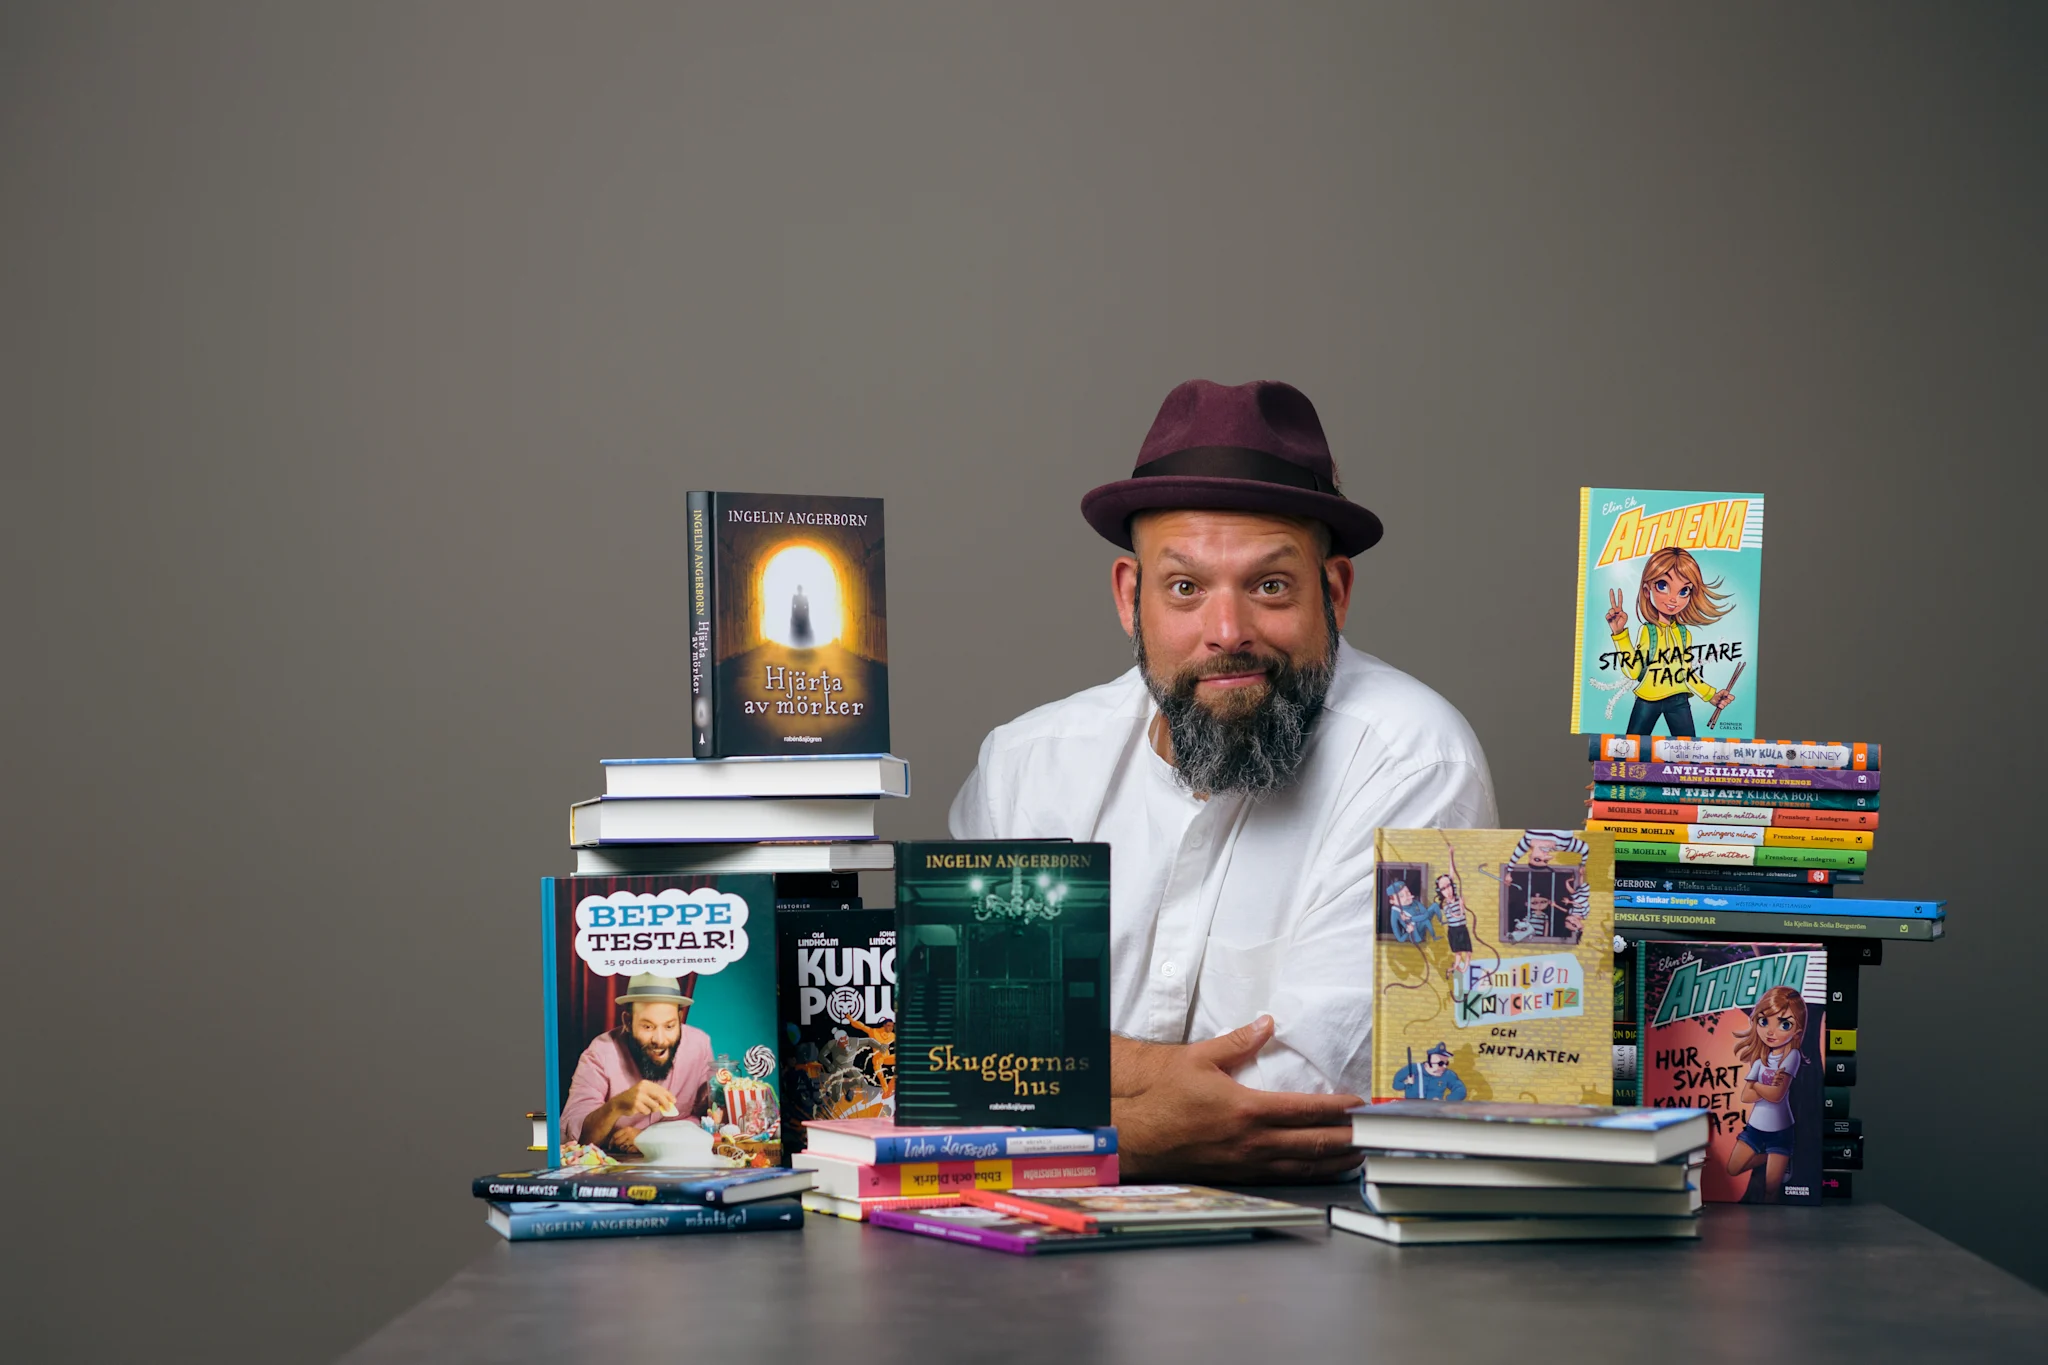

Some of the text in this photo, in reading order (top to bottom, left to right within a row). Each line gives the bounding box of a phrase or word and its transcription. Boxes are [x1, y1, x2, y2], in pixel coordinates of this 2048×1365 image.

[1602, 496, 1637, 515] Elin Ek
[728, 510, 868, 526] INGELIN ANGERBORN
[1597, 500, 1749, 567] ATHENA
[694, 510, 705, 616] INGELIN ANGERBORN
[695, 621, 710, 658] Hjärta
[1599, 641, 1742, 670] STRÅLKASTARE
[692, 637, 703, 694] av mörker
[765, 666, 843, 698] Hjärta
[1649, 666, 1704, 686] TACK!
[744, 691, 864, 715] av mörker
[1663, 741, 1690, 753] Dagbok
[1734, 748, 1841, 761] PÅ NY KULA KINNEY
[1676, 751, 1689, 759] alla
[1712, 751, 1729, 760] fans
[1662, 765, 1775, 778] ANTI-KILLPAKT
[1704, 776, 1742, 784] GAHRTON
[1662, 787, 1820, 802] EN TJEJ ATT KLICKA BORT
[1607, 806, 1679, 816] MORRIS MOHLIN
[1604, 826, 1675, 836] MORRIS MOHLIN
[1697, 829, 1735, 840] Sanningens
[1633, 848, 1667, 856] MOHLIN
[1685, 846, 1750, 860] Djupt vatten
[926, 854, 1092, 869] INGELIN ANGERBORN
[1678, 881, 1705, 891] Flickan
[1636, 895, 1645, 903] Så
[1646, 895, 1669, 904] funkar
[1670, 897, 1698, 906] Sverige
[589, 903, 732, 928] BEPPE
[1614, 913, 1716, 925] EMSKASTE SJUKDOMAR
[1794, 920, 1813, 929] Kjellin
[1835, 922, 1866, 930] Bergström
[588, 930, 735, 952] TESTAR!
[798, 938, 839, 947] LINDHOLM
[604, 955, 717, 967] 15 godisexperiment
[1659, 951, 1695, 971] Elin Ek
[1654, 954, 1808, 1026] ATHENA
[1491, 1027, 1517, 1038] OCH
[1478, 1043, 1580, 1064] SNUTJAKTEN
[1656, 1046, 1702, 1070] HUR
[927, 1044, 1090, 1081] Skuggornas
[1013, 1068, 1061, 1096] hus
[1673, 1061, 1743, 1091] SVÅRT
[1653, 1092, 1734, 1110] KAN DET
[913, 1171, 1001, 1186] Ebba och Didrik
[1023, 1166, 1096, 1180] CHRISTINA HERRSTRÖM
[489, 1184, 559, 1196] CONNY PALMKVIST
[531, 1209, 747, 1233] INGELIN ANGERBORN månfågel
